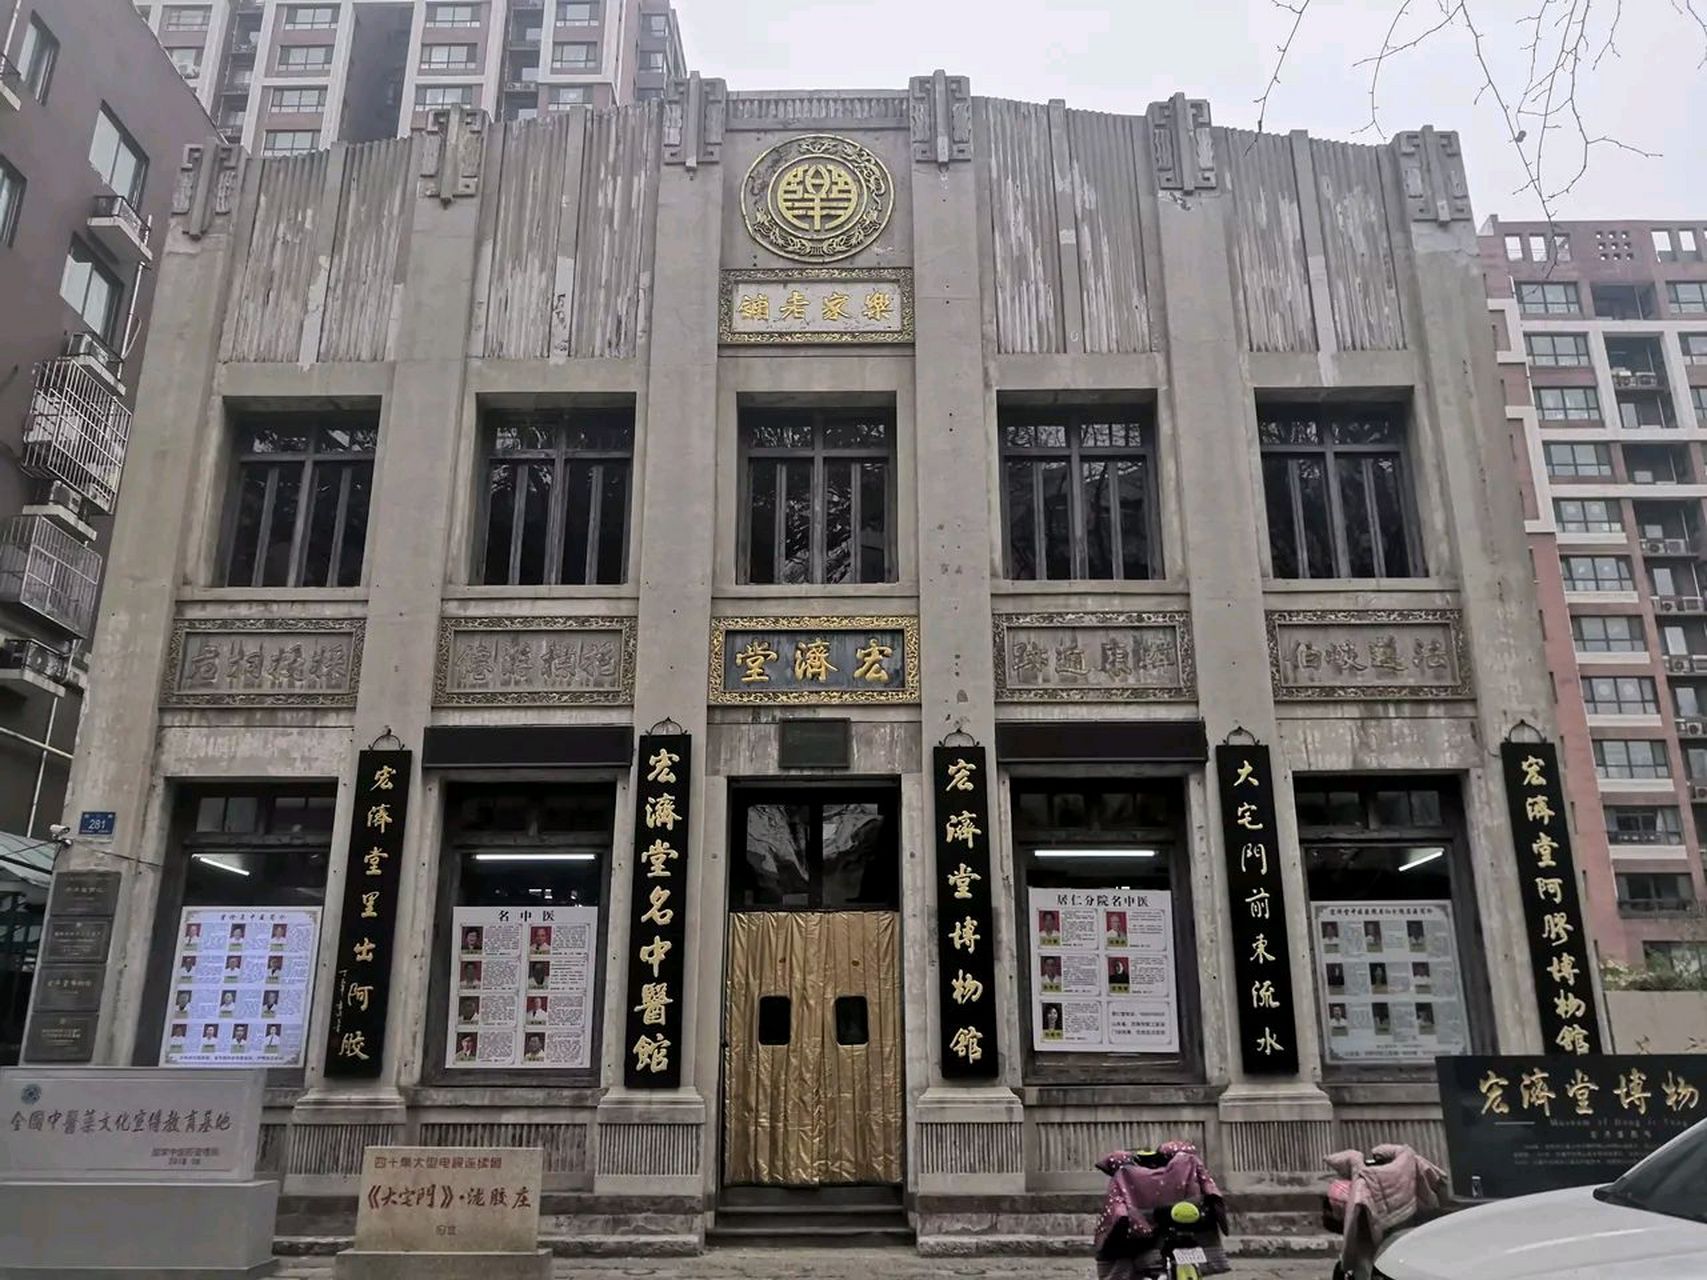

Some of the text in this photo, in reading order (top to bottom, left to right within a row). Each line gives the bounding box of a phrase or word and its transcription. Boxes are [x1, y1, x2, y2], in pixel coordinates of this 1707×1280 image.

[88, 819, 106, 830] 281
[1058, 894, 1149, 907] 居仁分院名中医
[498, 909, 555, 922] 名中医
